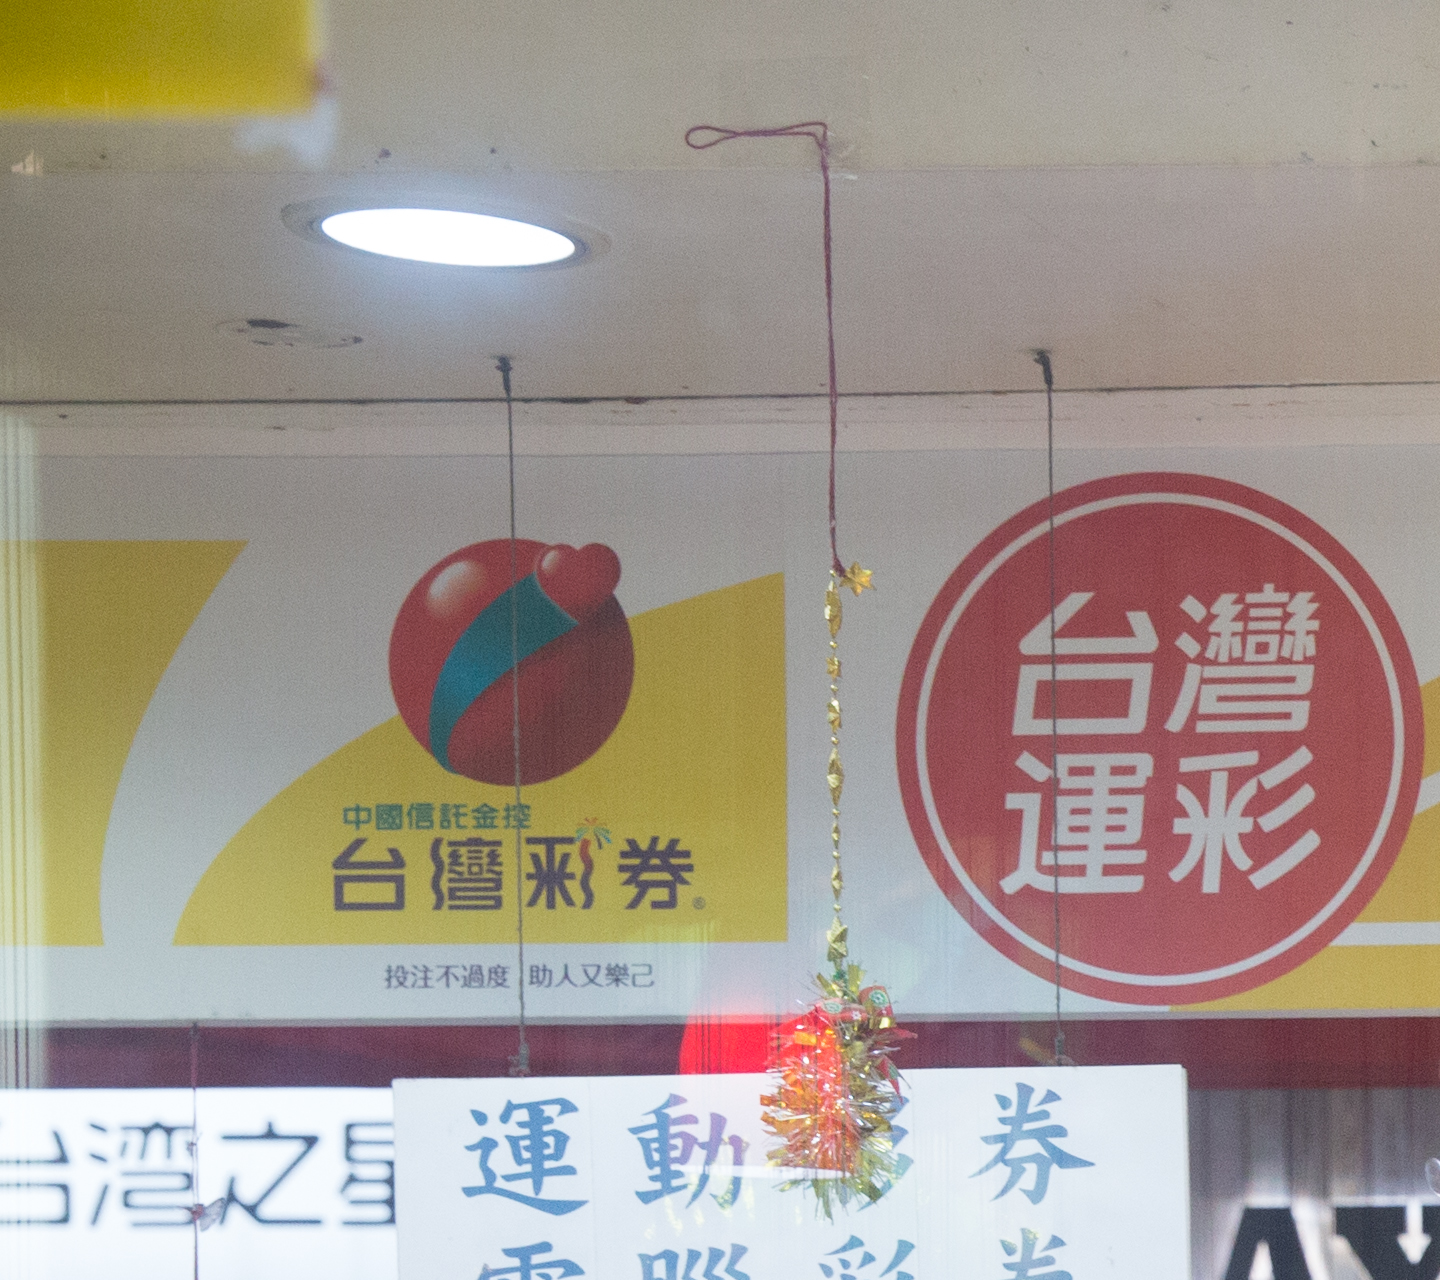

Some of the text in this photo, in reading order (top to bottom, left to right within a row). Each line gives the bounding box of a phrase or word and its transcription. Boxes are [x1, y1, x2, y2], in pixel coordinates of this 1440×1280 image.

[1012, 584, 1320, 735] 台灣
[342, 802, 532, 831] 中國信託金控
[999, 745, 1321, 894] 運彩
[384, 963, 656, 990] 投注不過度 助人又樂己
[460, 1082, 1095, 1215] 運動券
